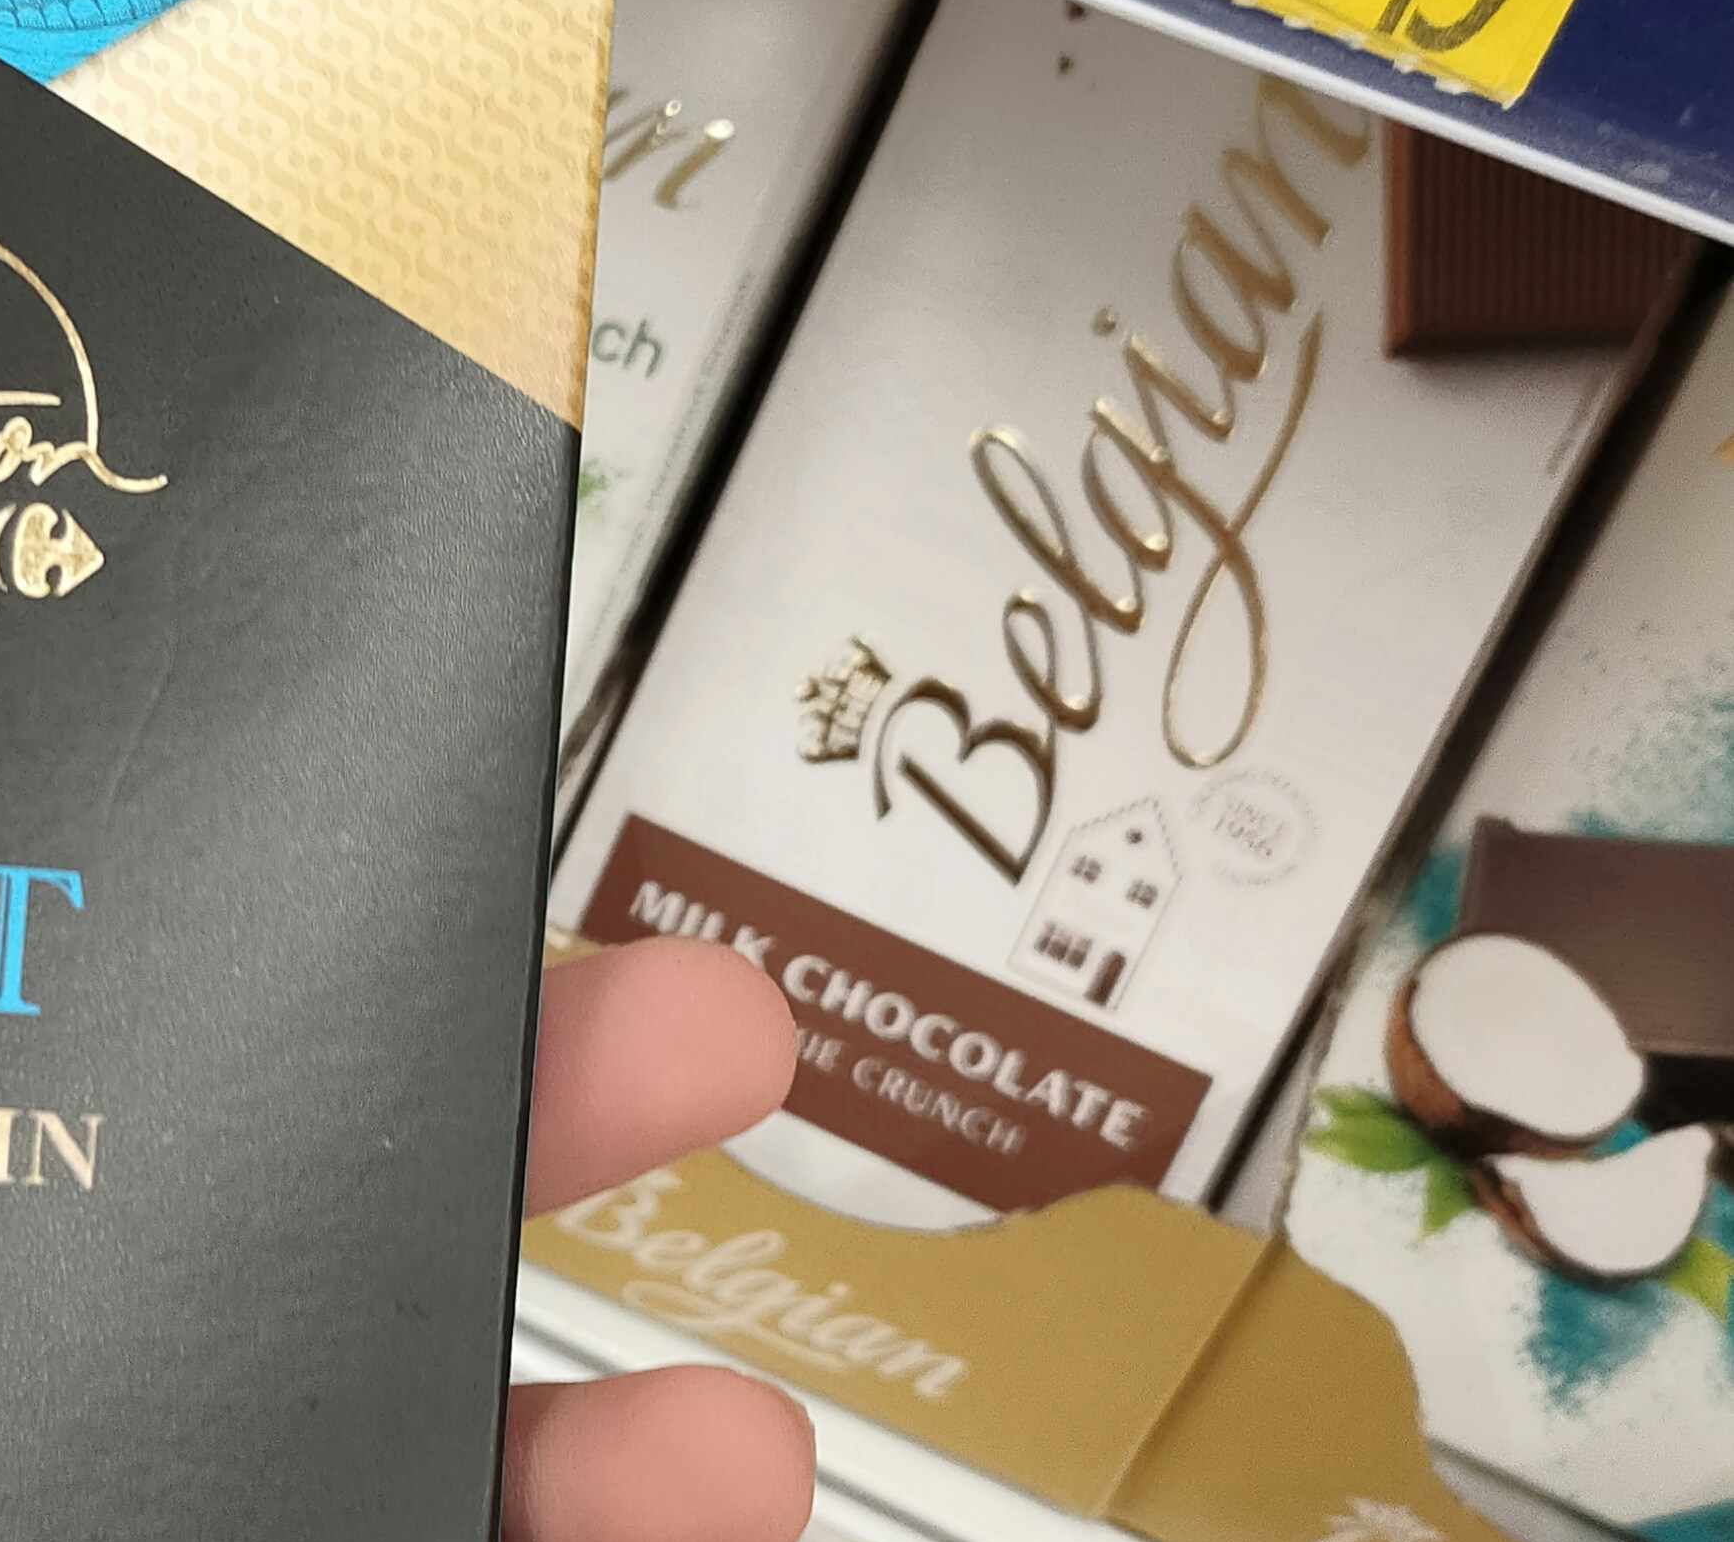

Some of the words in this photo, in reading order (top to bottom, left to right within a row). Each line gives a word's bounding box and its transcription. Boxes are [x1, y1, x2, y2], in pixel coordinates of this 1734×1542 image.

[875, 71, 1371, 885] Belgian
[781, 954, 1149, 1151] CHOCOLATE
[851, 1055, 1028, 1157] CRUNCH
[555, 1167, 968, 1400] Belgian
